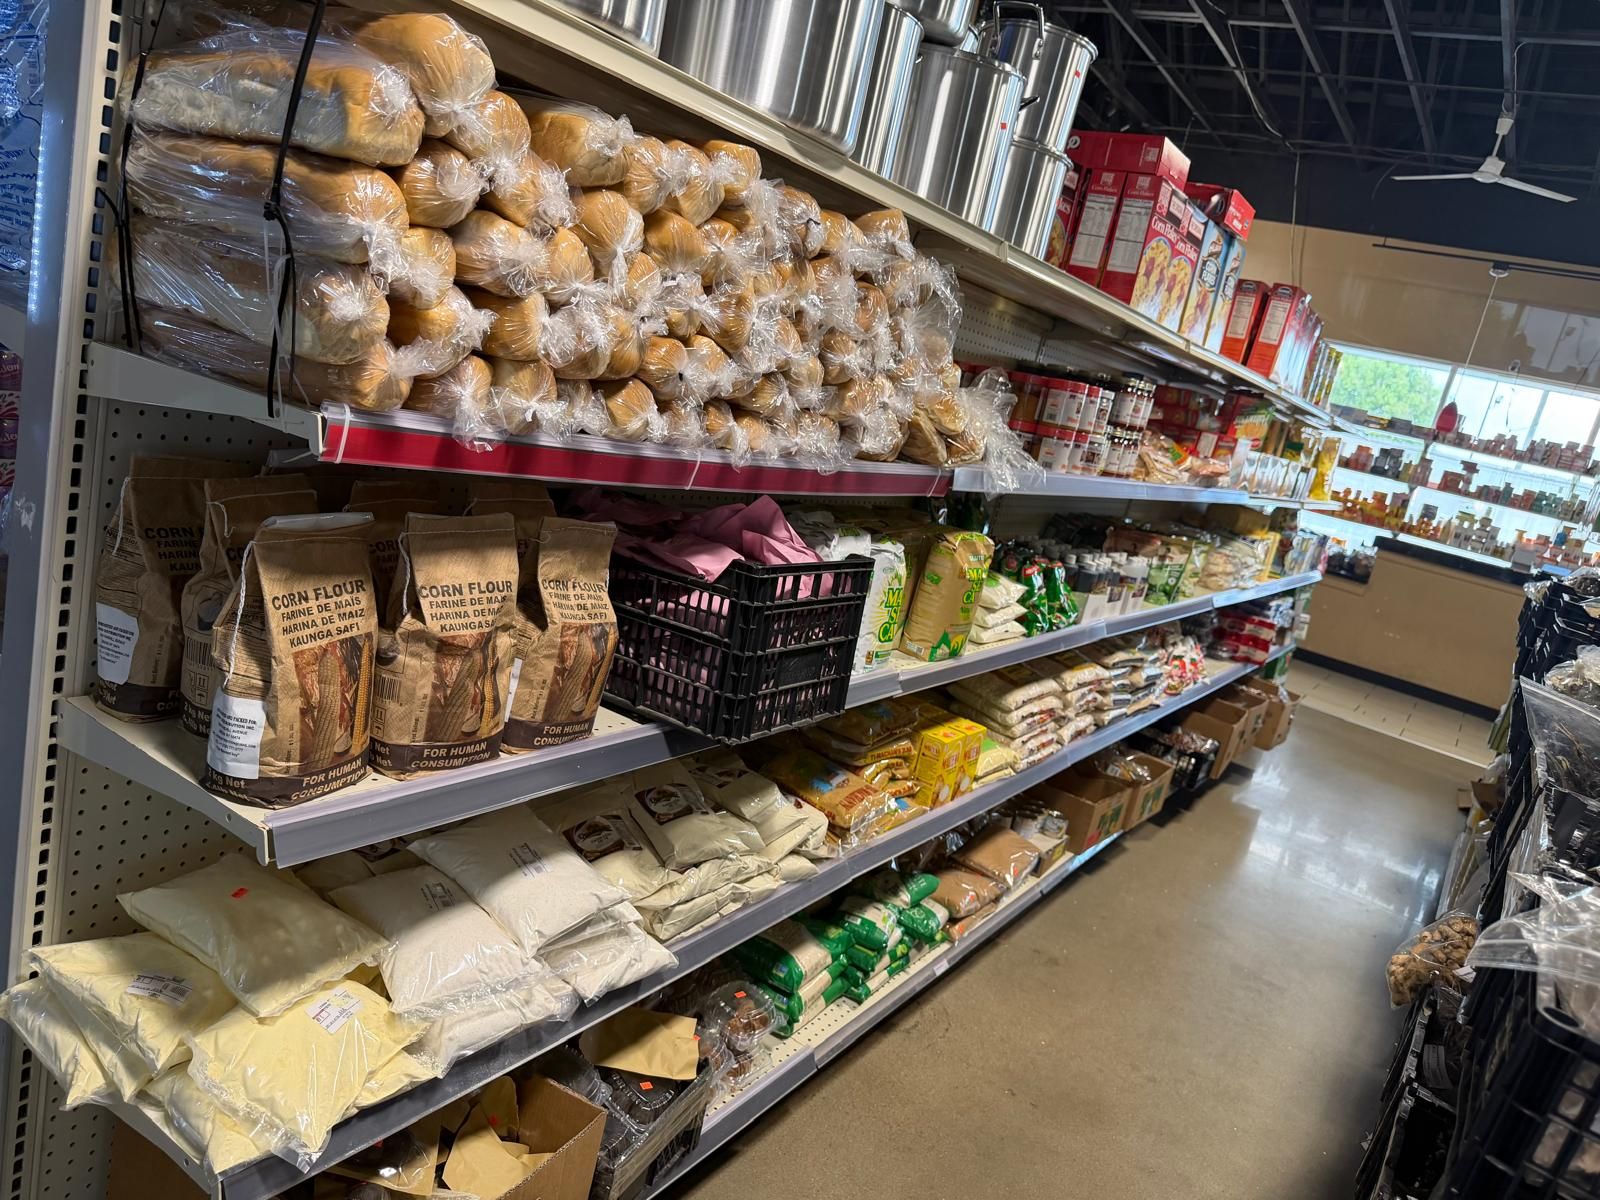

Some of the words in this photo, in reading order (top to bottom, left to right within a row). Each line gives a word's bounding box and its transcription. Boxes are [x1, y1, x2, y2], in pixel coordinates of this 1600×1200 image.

[1151, 215, 1166, 233] Corn
[145, 527, 194, 539] CORN
[158, 551, 200, 560] HARIN
[170, 563, 201, 572] KAUN
[420, 583, 464, 599] CORN
[468, 580, 513, 595] FLOUR
[541, 579, 569, 592] CORN
[572, 580, 606, 593] FLOUR
[272, 590, 309, 611] CORN
[313, 579, 366, 601] FLOUR
[549, 592, 571, 602] FARINE
[573, 593, 586, 601] DE
[281, 606, 314, 622] FARINE
[317, 602, 331, 613] DE
[335, 596, 361, 610] MAÏS
[429, 598, 467, 609] FARINE
[470, 597, 484, 607] DE
[552, 601, 575, 612] HARINA
[576, 603, 589, 611] DE
[590, 602, 609, 611] MAIZ
[282, 620, 319, 636] HARINA
[321, 615, 335, 626] DE
[338, 608, 365, 622] MAIZ
[430, 610, 470, 621] HARINA
[473, 609, 486, 618] DE
[560, 611, 586, 621] KAUNGA
[587, 612, 607, 620] SAFI
[440, 621, 483, 633] KAUNGA
[289, 629, 334, 648] KAUNGA
[335, 622, 360, 636] SAFI
[197, 710, 210, 721] Ne
[543, 726, 562, 735] FOR
[563, 722, 590, 734] HUMAN
[423, 748, 447, 758] FOR
[450, 741, 488, 756] HUMAN
[411, 752, 491, 769] CONSUMPTION
[302, 772, 325, 788] FOR
[328, 757, 362, 780] HUMAN
[212, 772, 223, 785] kg
[225, 776, 246, 788] Net
[291, 766, 367, 801] CONSUMPTION
